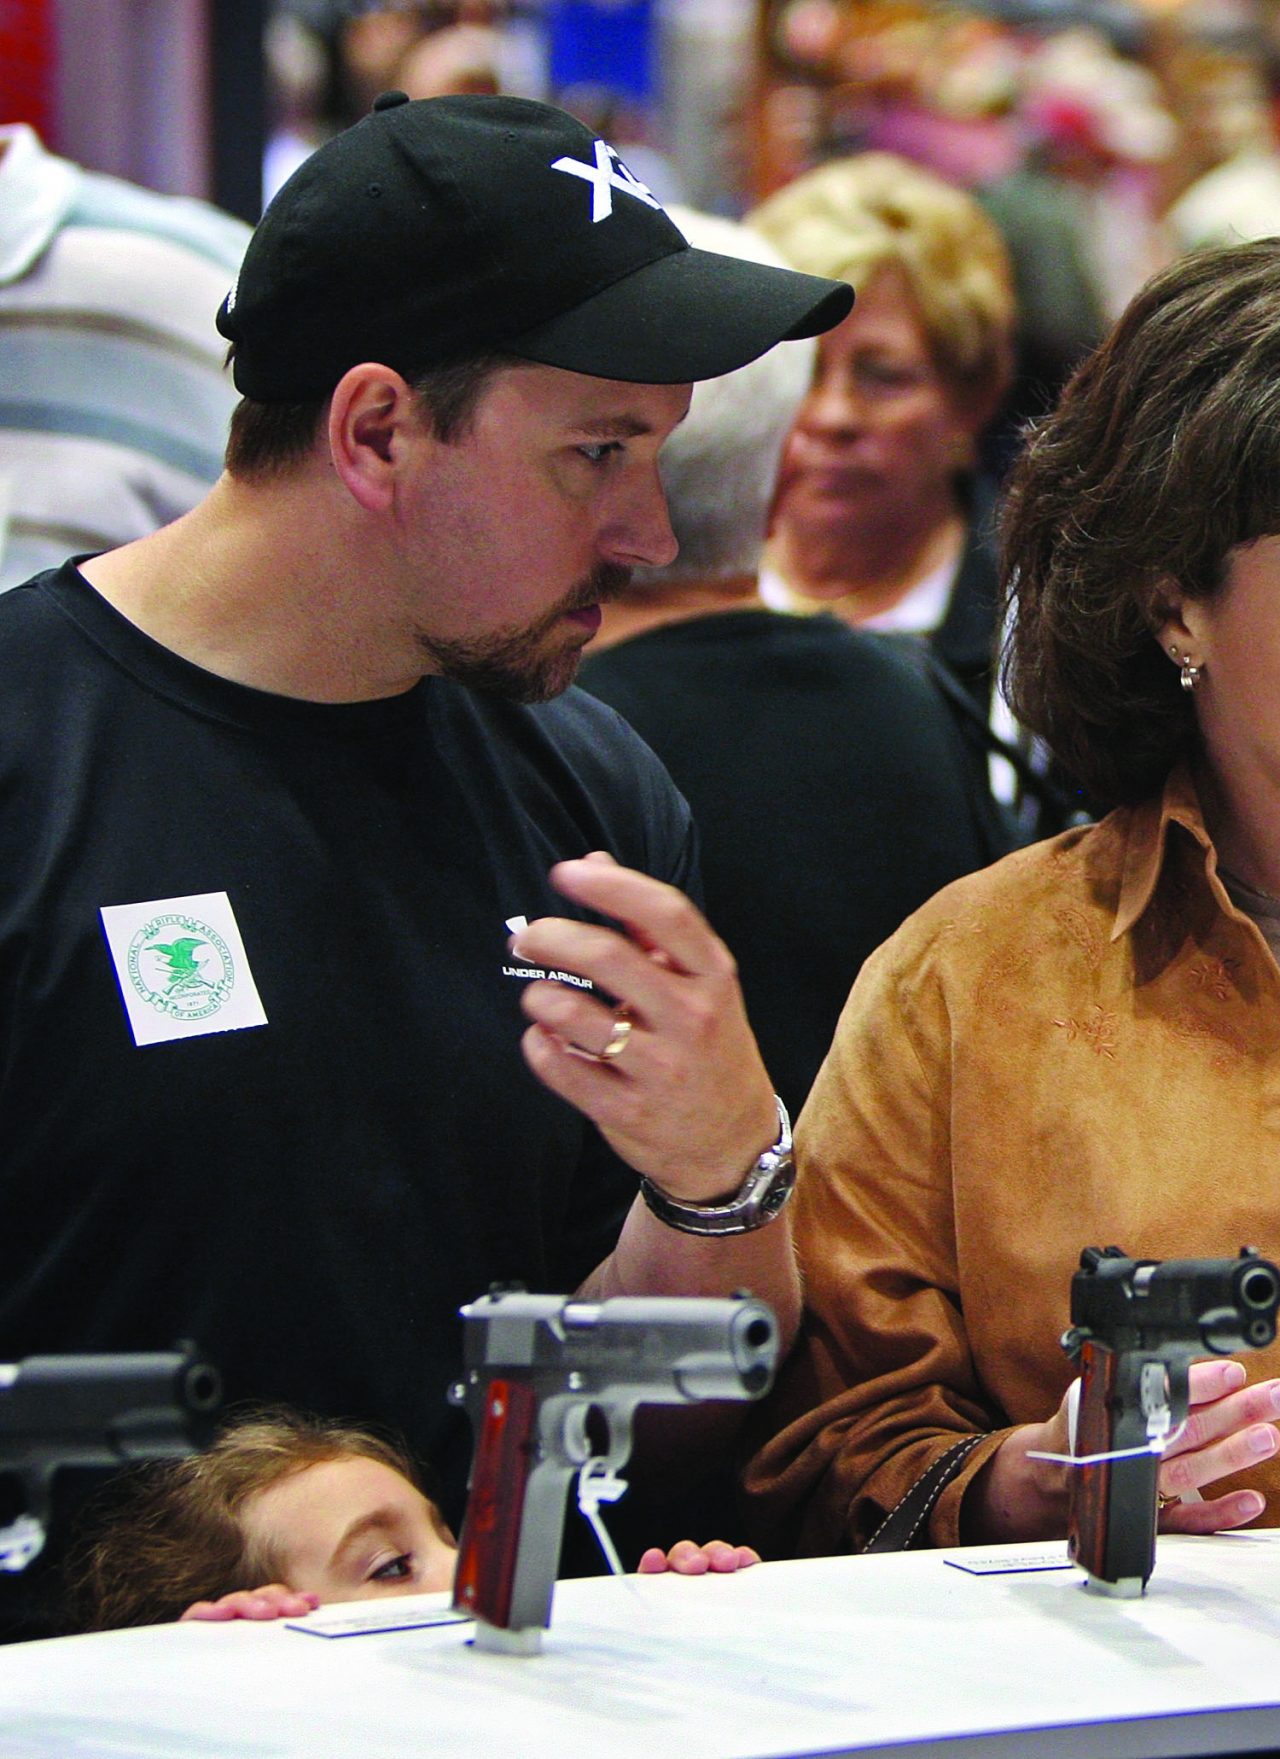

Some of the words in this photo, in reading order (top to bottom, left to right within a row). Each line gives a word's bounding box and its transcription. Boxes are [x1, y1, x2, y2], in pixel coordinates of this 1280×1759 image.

[130, 943, 146, 993] NATIONAL
[155, 916, 182, 926] RIFLE
[200, 926, 234, 985] ASSOCIATION
[502, 966, 546, 979] UNDER
[548, 970, 593, 989] ARMOUR
[187, 1004, 218, 1017] AMERICA
